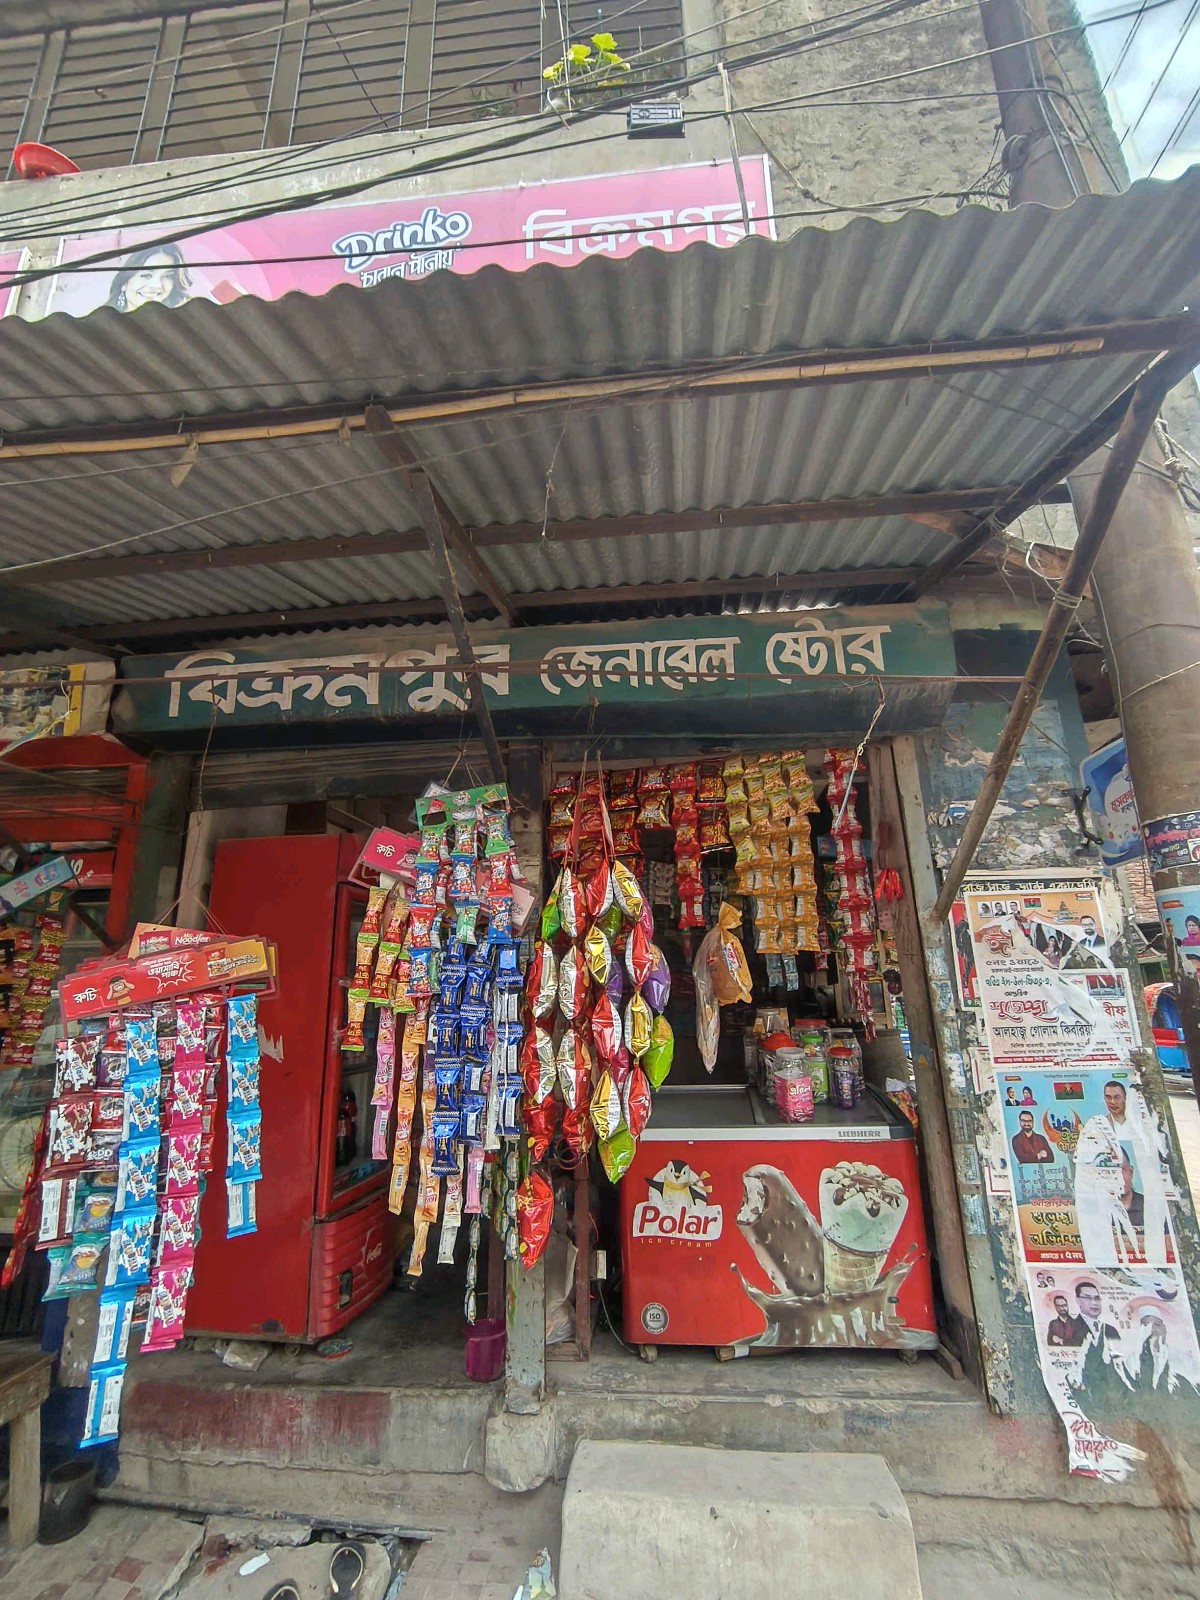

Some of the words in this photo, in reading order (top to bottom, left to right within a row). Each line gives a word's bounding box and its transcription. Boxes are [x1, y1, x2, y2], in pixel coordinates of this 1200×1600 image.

[333, 207, 471, 271] Drinko
[540, 636, 741, 695] জেনারেল
[376, 843, 396, 857] রুচি
[174, 934, 210, 946] Noodles
[73, 988, 98, 1003] রুচি
[1029, 1024, 1058, 1039] গোলাম
[838, 1130, 881, 1138] LIEBHERR
[638, 1205, 718, 1234] Polar
[1030, 1209, 1073, 1225] শুভেচ্ছা
[641, 1236, 662, 1244] ice
[670, 1239, 712, 1248] cream
[649, 1312, 661, 1320] ISO
